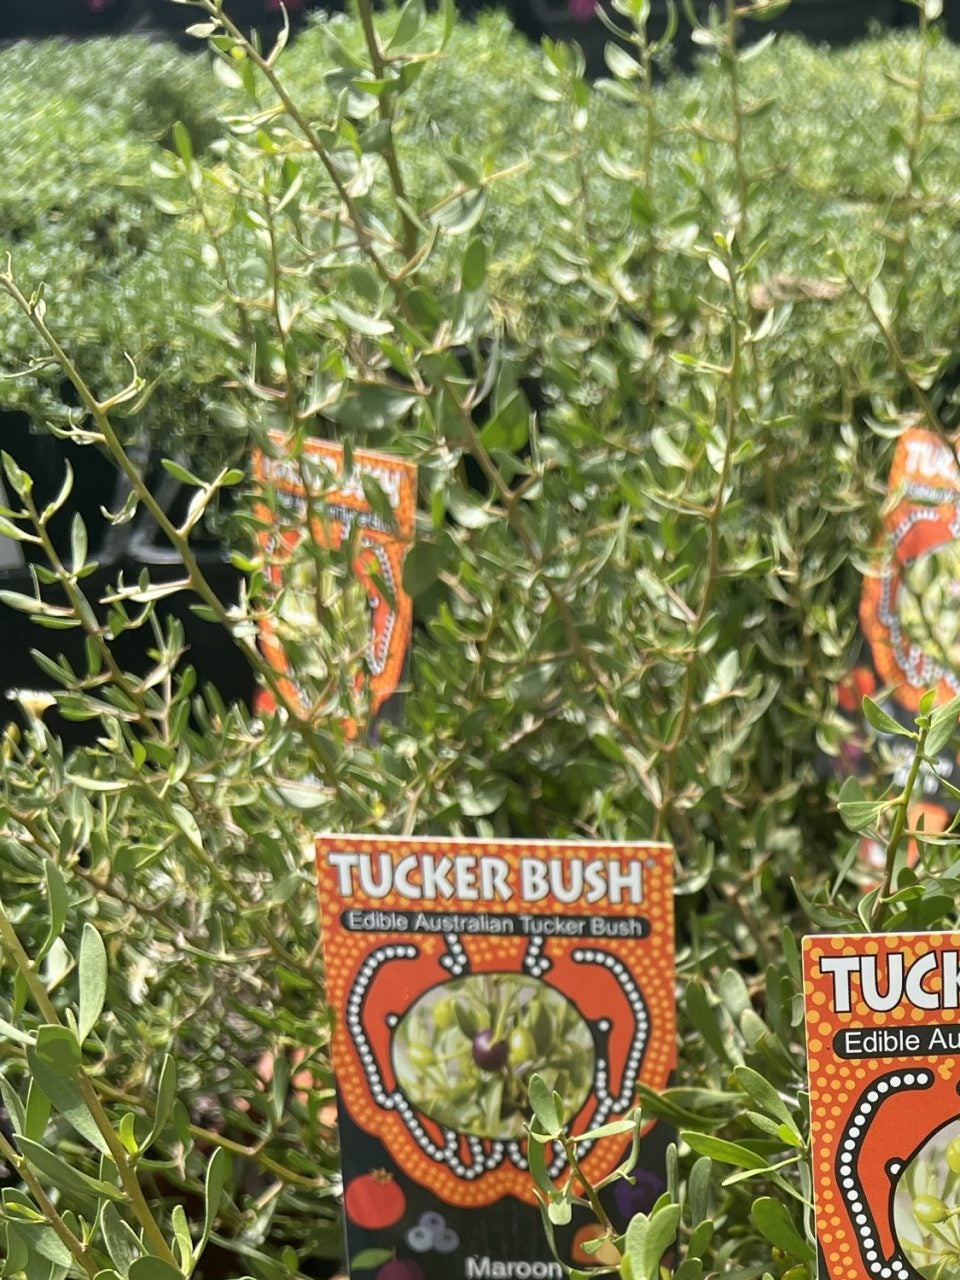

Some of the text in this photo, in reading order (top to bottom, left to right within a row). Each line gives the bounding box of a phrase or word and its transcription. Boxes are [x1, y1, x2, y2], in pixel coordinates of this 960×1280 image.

[327, 852, 513, 901] TUCKER
[349, 911, 642, 936] Edible Australian Tucker Bush
[844, 1028, 920, 1055] Edible
[465, 1254, 563, 1280] Maroon
